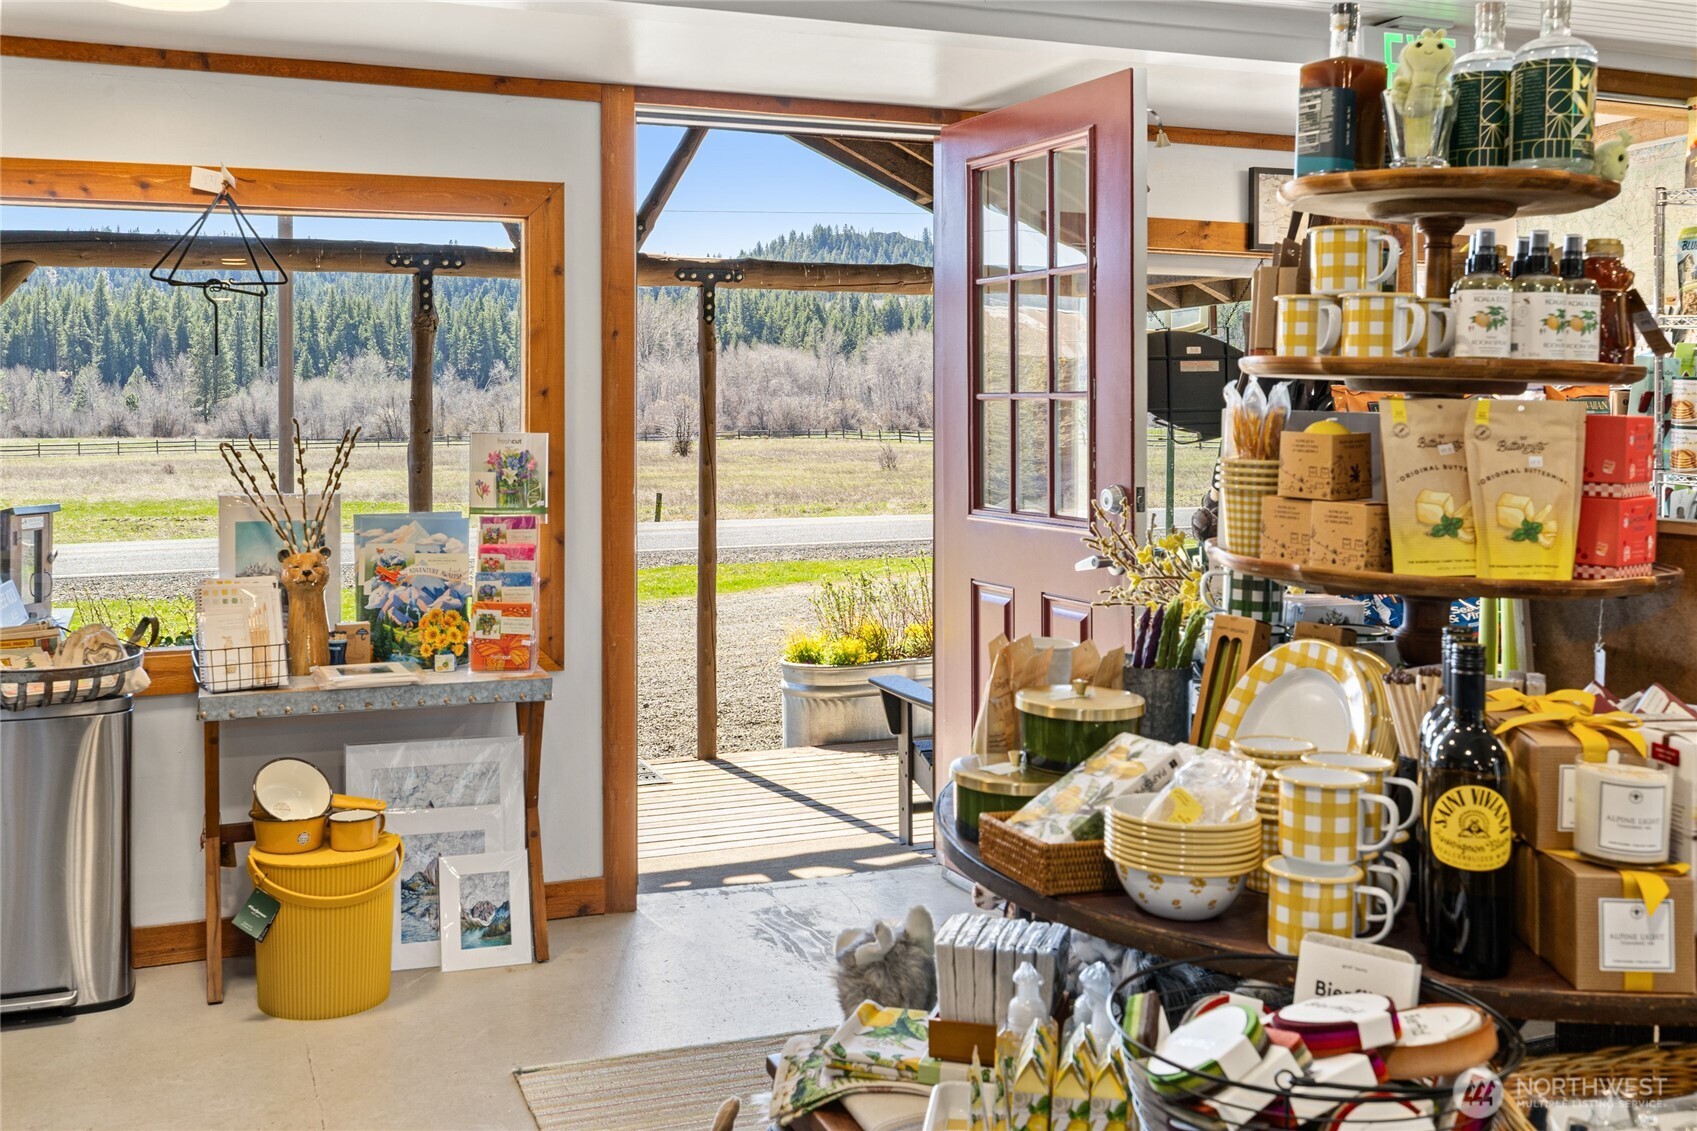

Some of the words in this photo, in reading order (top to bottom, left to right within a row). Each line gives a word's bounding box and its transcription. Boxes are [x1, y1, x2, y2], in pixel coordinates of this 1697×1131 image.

[1400, 464, 1439, 482] ORIGINAL
[1478, 468, 1521, 486] ORIGINAL
[409, 567, 439, 576] ADVENTURE
[1434, 790, 1466, 829] SAINT
[1471, 788, 1509, 834] VIVIANA
[1607, 815, 1636, 825] ALPINE
